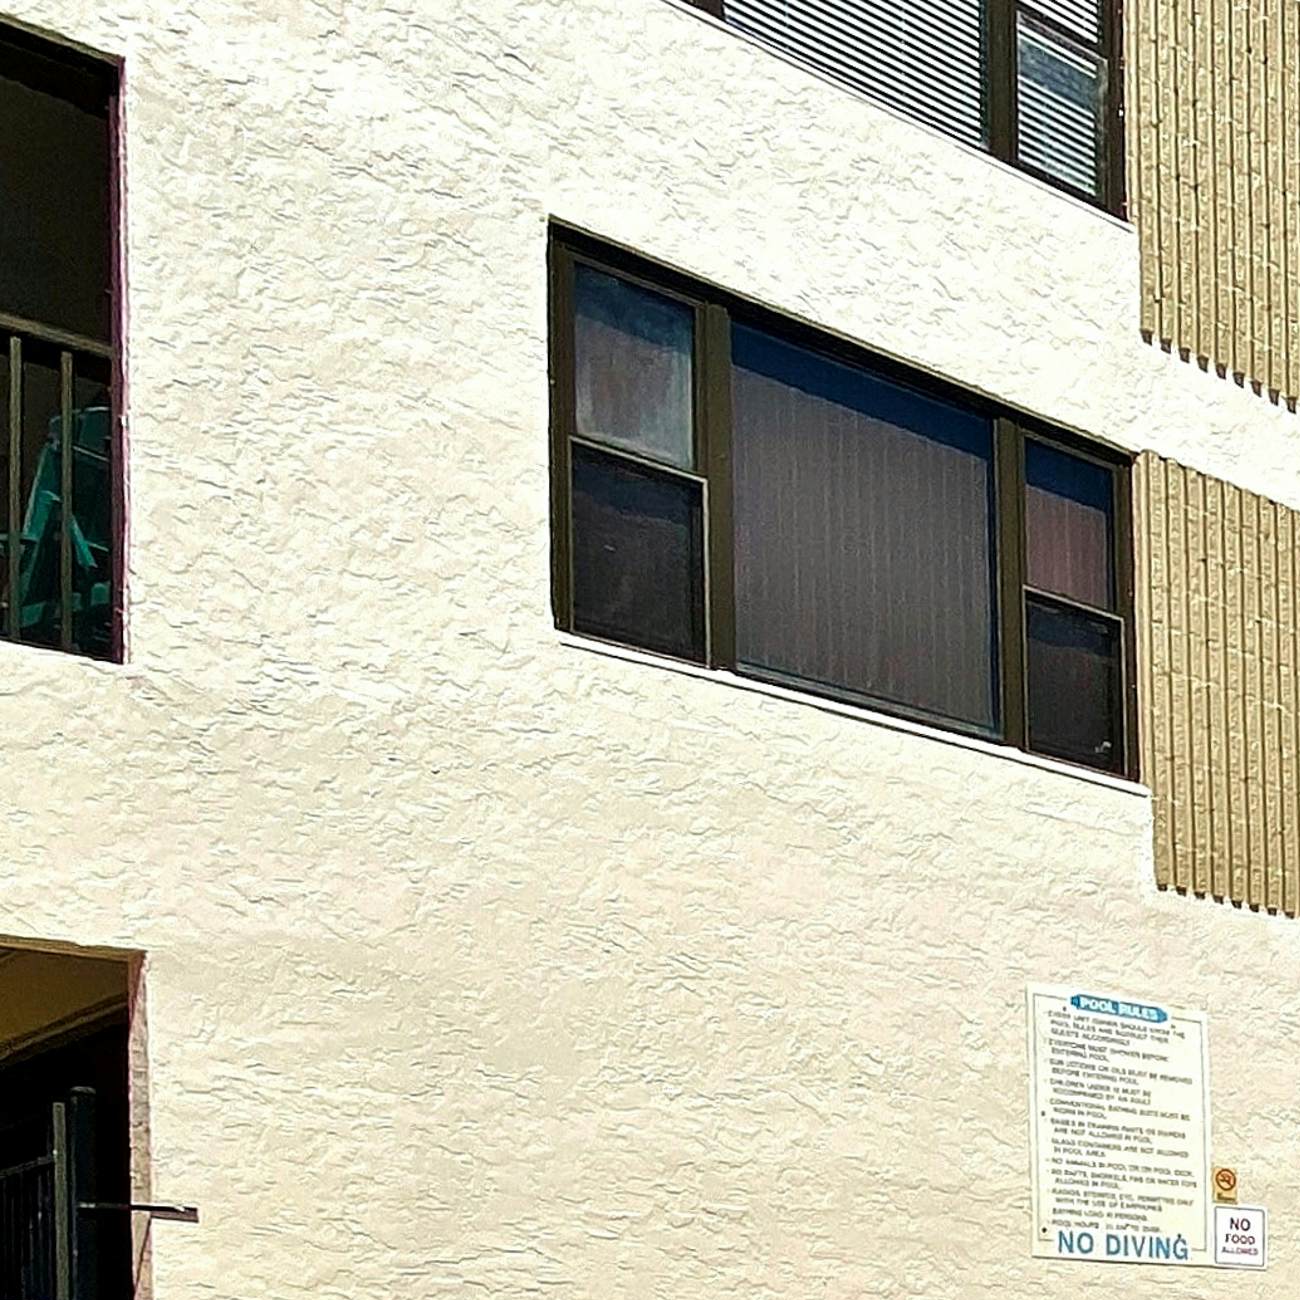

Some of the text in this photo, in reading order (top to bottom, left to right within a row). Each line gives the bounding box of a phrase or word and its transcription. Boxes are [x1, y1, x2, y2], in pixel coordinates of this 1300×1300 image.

[1079, 997, 1160, 1021] POOL RULES
[1230, 1217, 1251, 1231] NO
[1058, 1231, 1189, 1260] NO DIVING
[1225, 1233, 1255, 1245] FOOD
